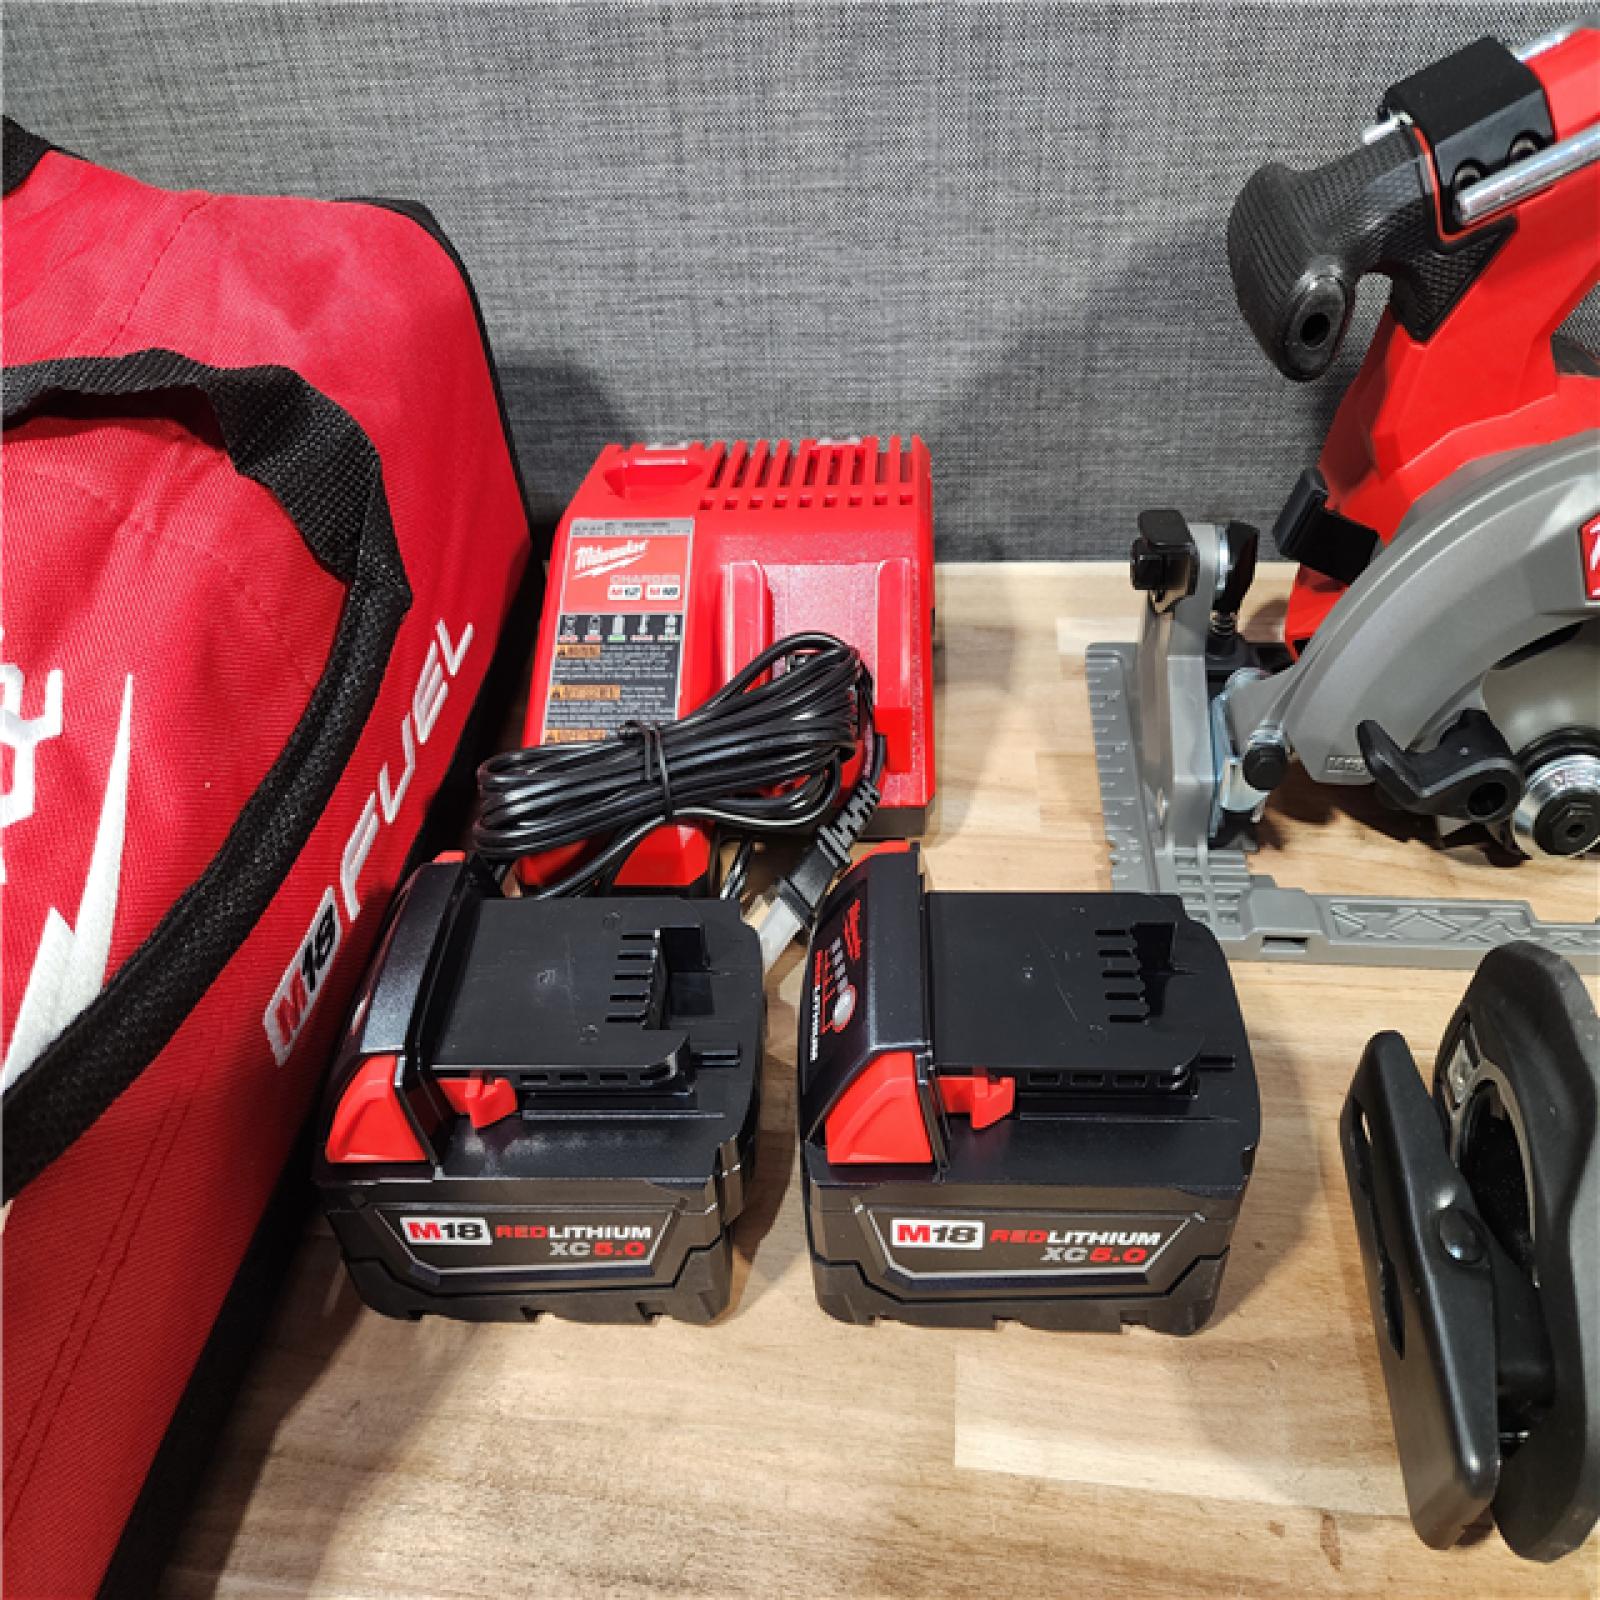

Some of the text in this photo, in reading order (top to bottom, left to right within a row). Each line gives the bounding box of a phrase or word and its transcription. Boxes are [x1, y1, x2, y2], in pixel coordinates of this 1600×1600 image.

[274, 617, 474, 1048] M18 FUEL
[406, 1221, 484, 1241] M18
[495, 1224, 651, 1240] REDLITHIUM
[896, 1224, 979, 1244] M18
[989, 1229, 1162, 1246] REDLITHIUM
